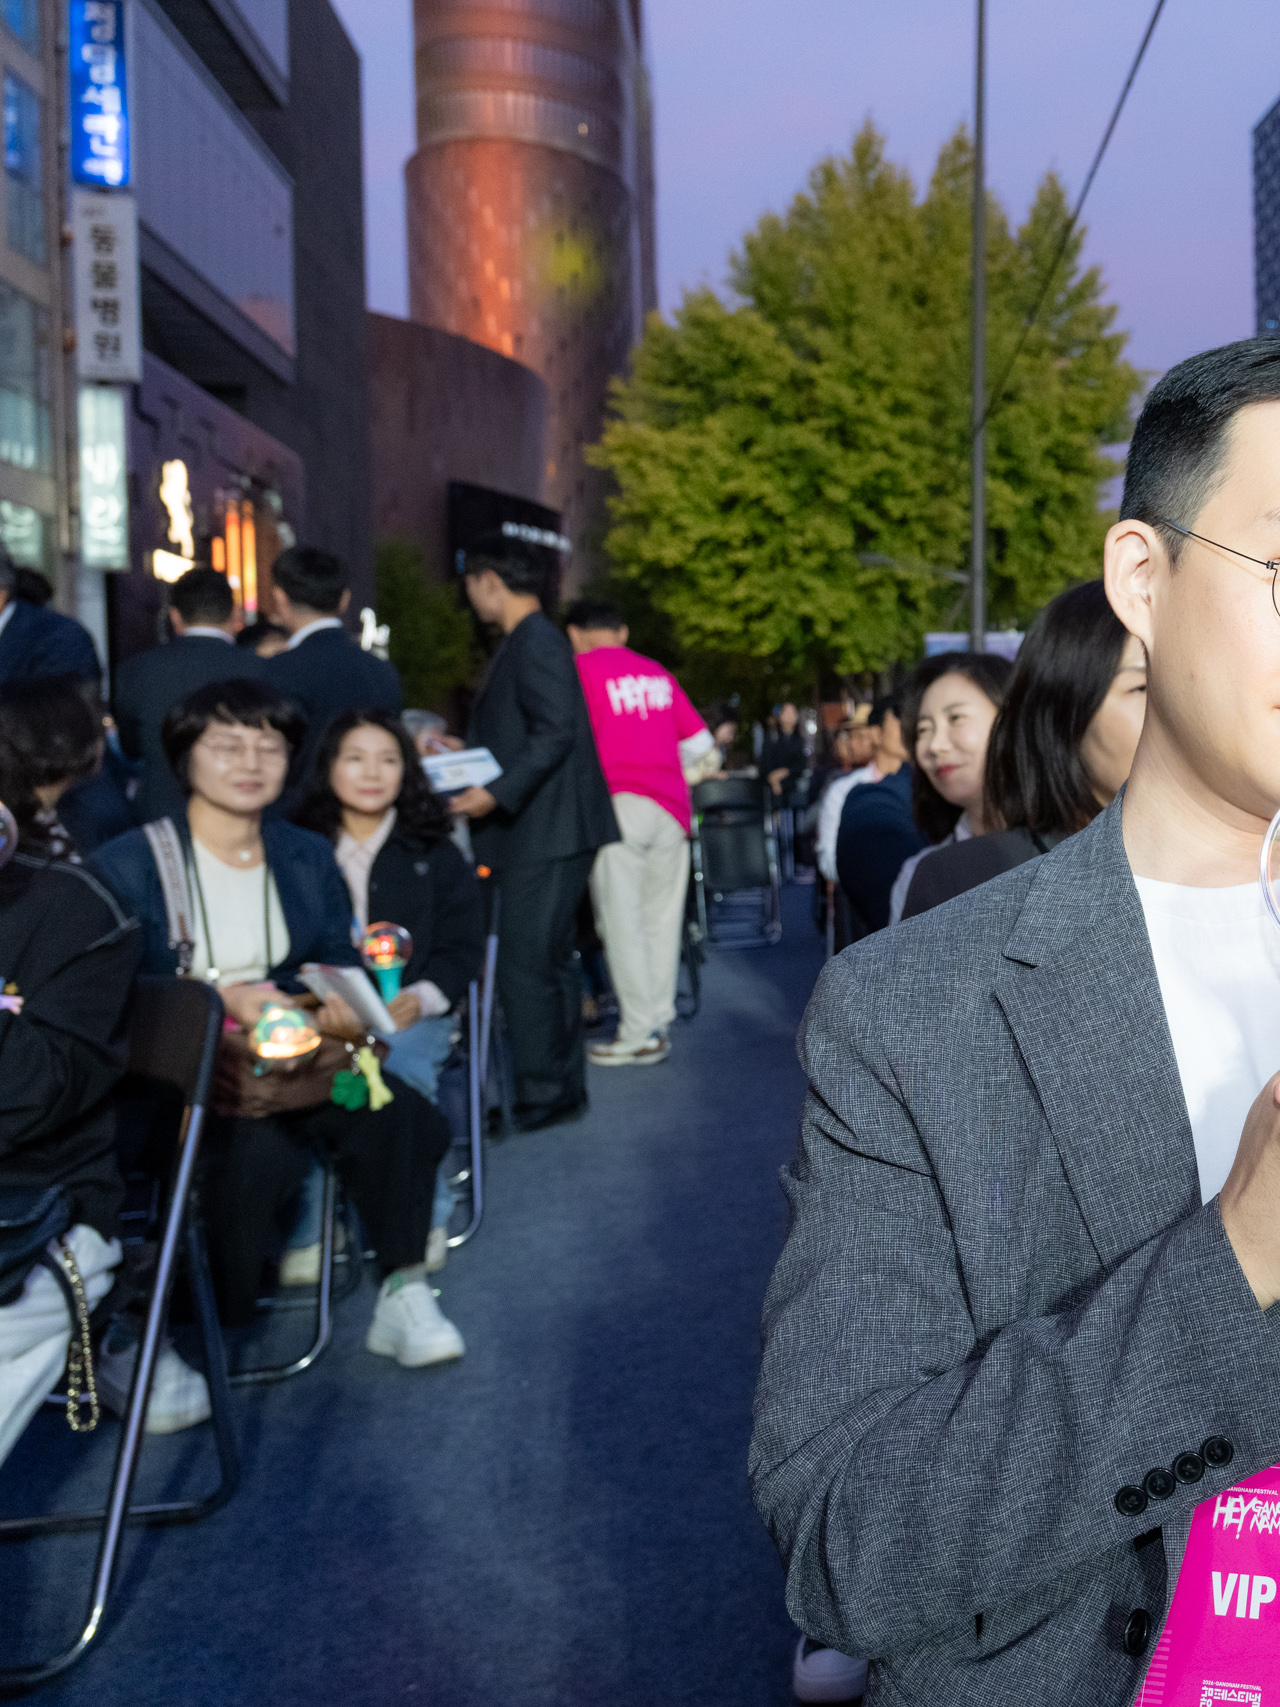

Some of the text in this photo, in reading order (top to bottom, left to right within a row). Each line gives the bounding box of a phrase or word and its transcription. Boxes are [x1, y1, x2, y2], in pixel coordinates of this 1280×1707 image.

[1253, 1488, 1279, 1496] FESTIVAL
[1212, 1493, 1258, 1539] HEY
[1211, 1570, 1278, 1620] VIP
[1240, 1683, 1263, 1693] FESTIVAL
